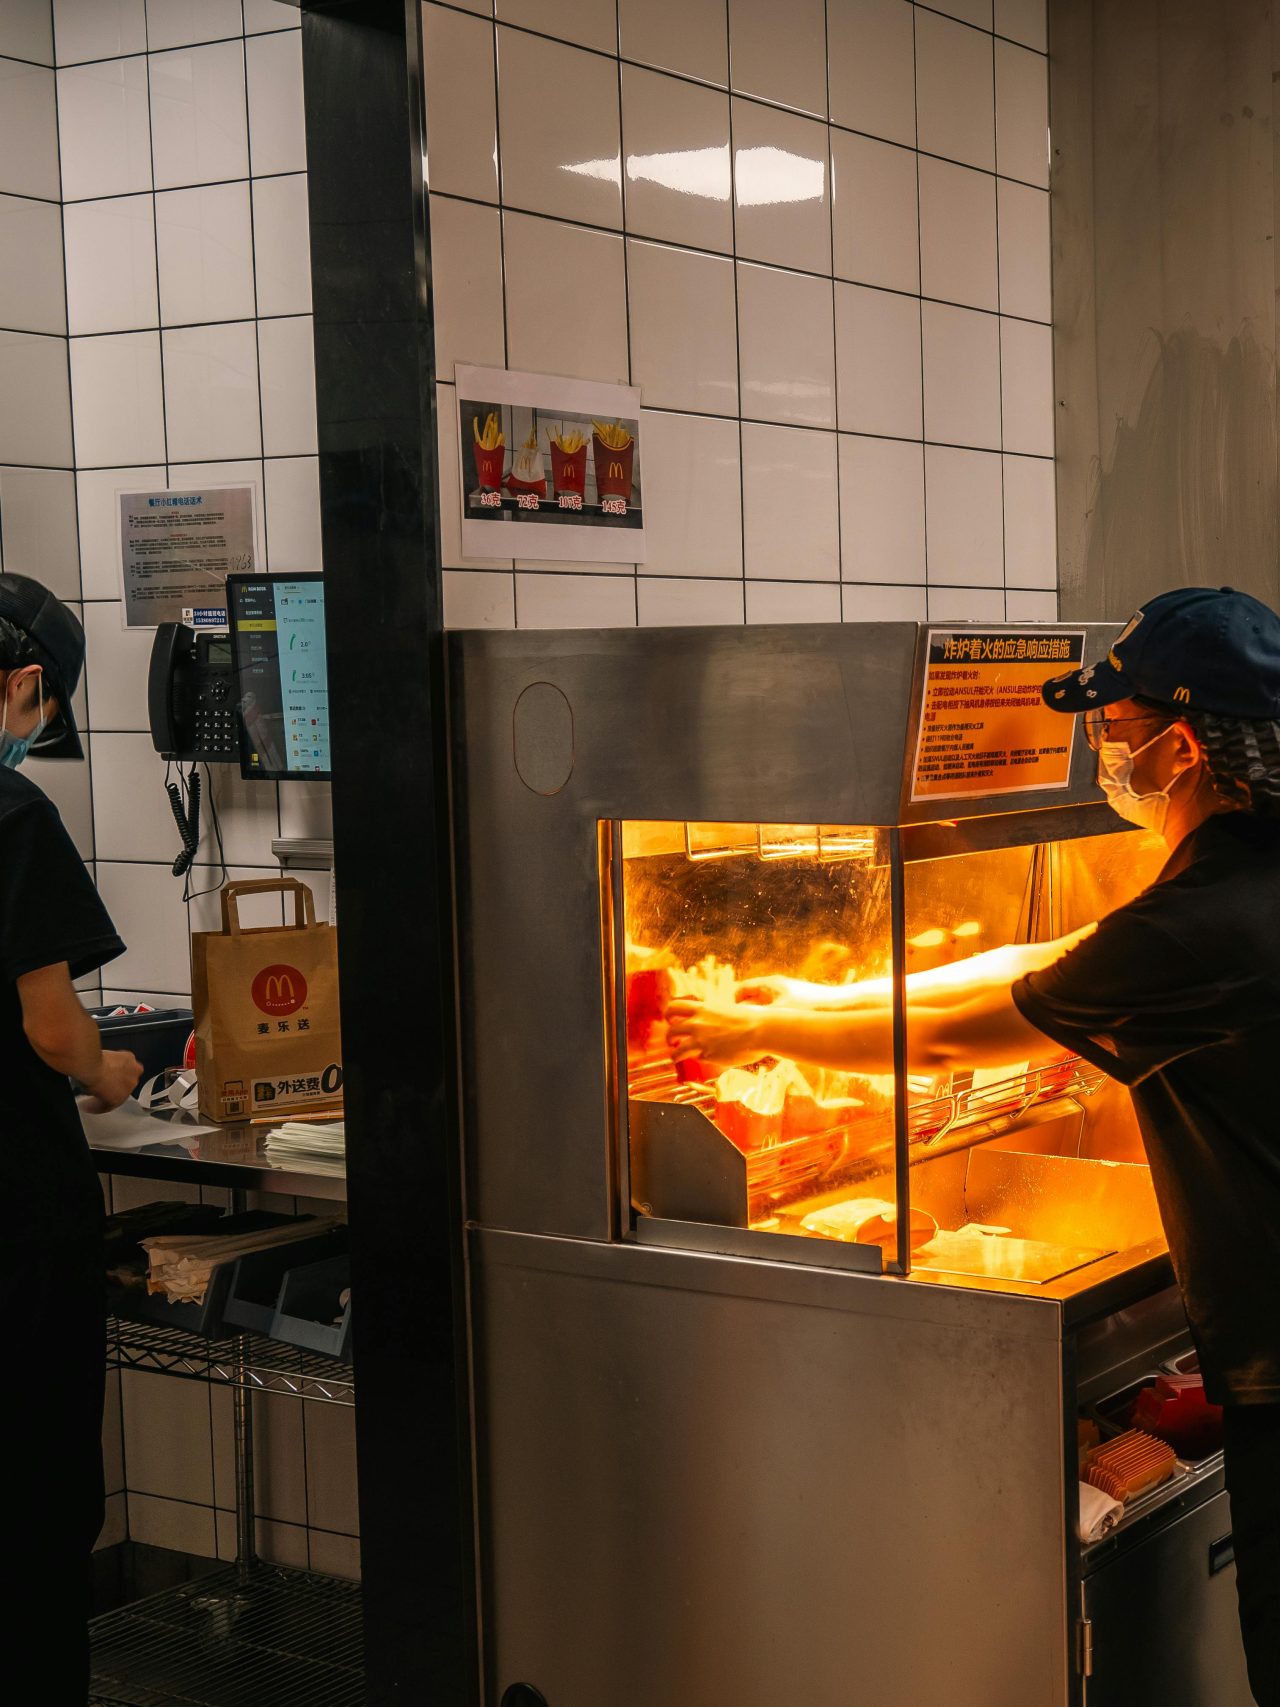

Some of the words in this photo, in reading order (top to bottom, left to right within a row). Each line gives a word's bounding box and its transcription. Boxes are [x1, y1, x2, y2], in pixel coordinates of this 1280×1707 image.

[481, 492, 501, 507] 36克
[517, 494, 539, 510] 72克
[559, 495, 582, 510] 107克
[602, 500, 627, 515] 145克
[943, 638, 1071, 660] 炸炉着火的应急响应措施
[257, 1019, 310, 1035] 麦乐送
[277, 1077, 321, 1095] 外送费
